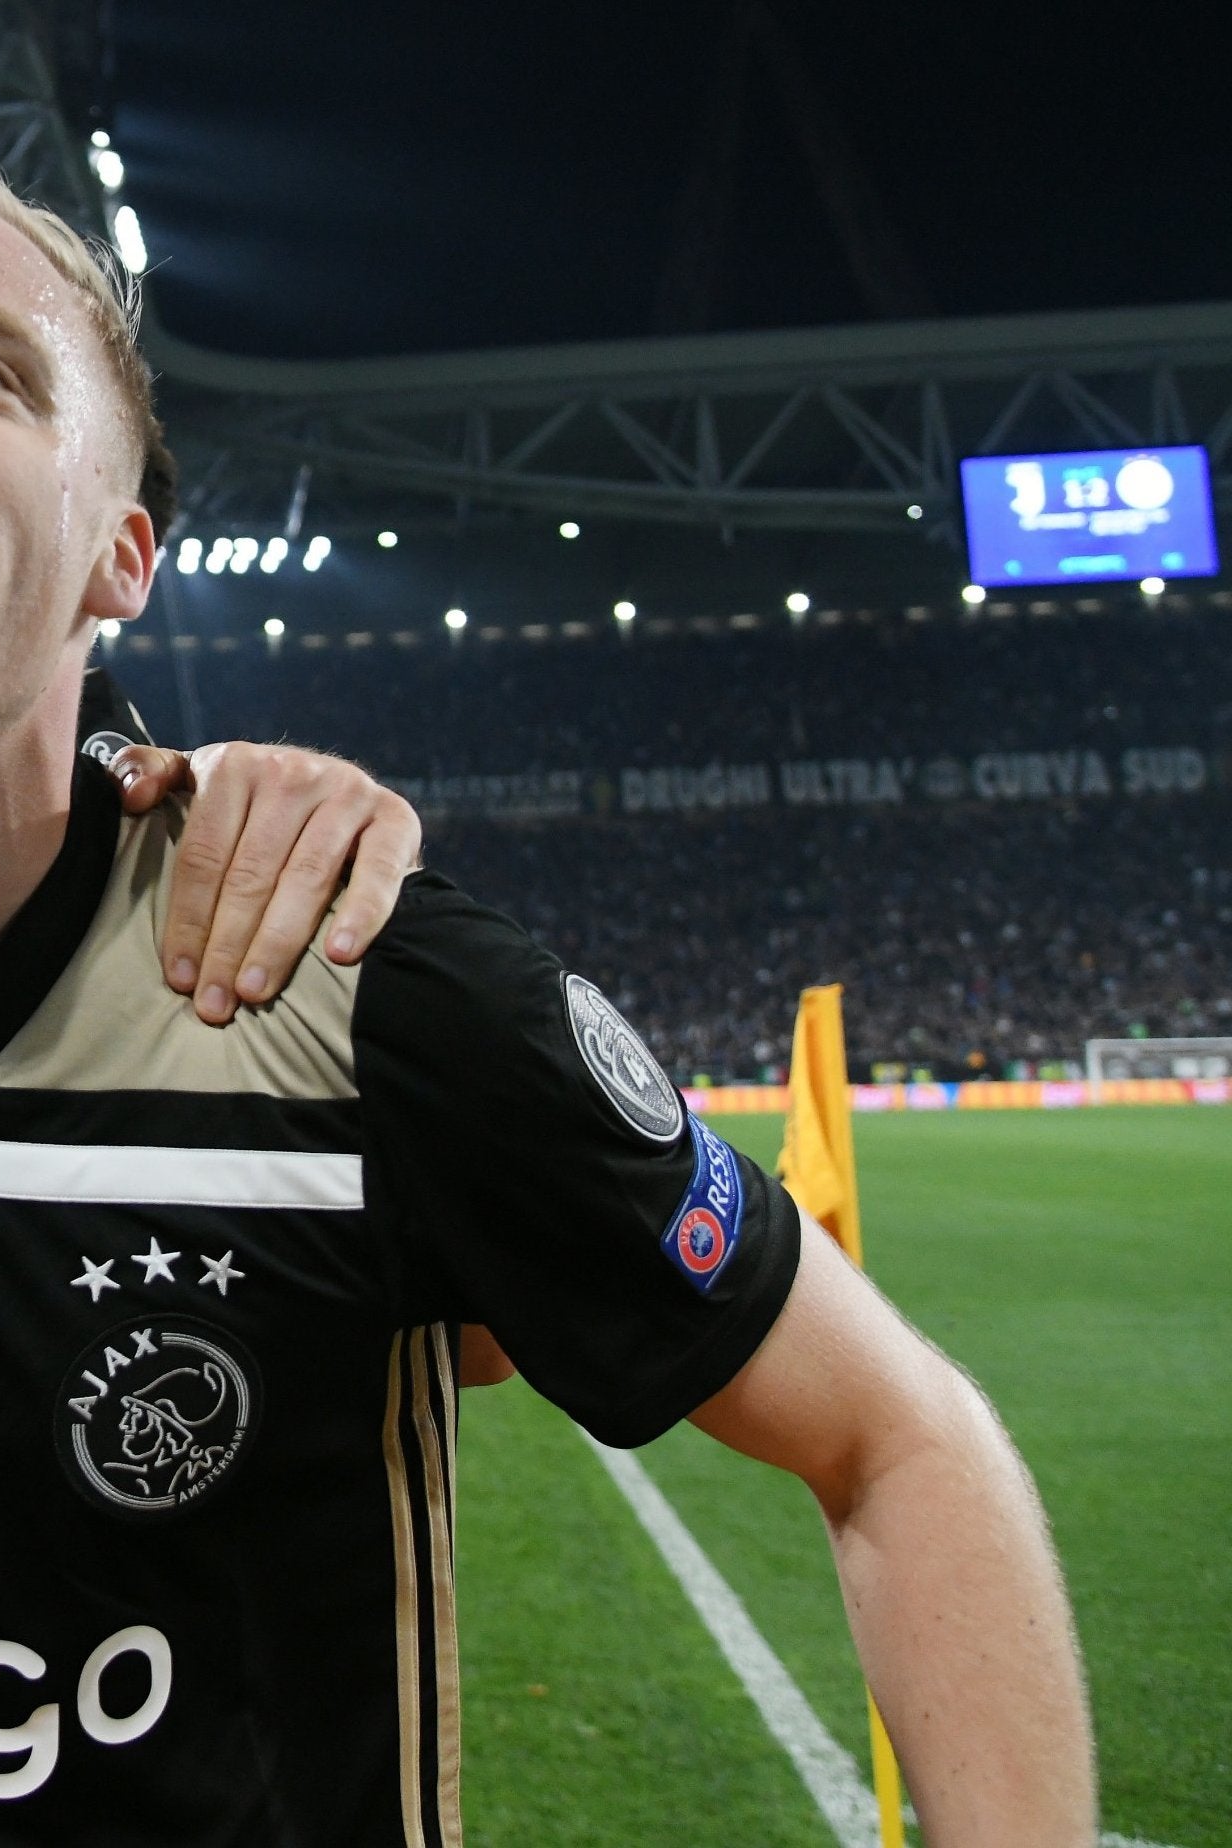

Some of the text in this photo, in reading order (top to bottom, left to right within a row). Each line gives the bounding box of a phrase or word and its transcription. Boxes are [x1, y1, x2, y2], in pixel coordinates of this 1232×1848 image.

[973, 750, 1112, 798] CURVA
[1121, 747, 1206, 795] SUD
[68, 1328, 159, 1421] AJAX
[179, 1429, 246, 1503] AMSTERDAM
